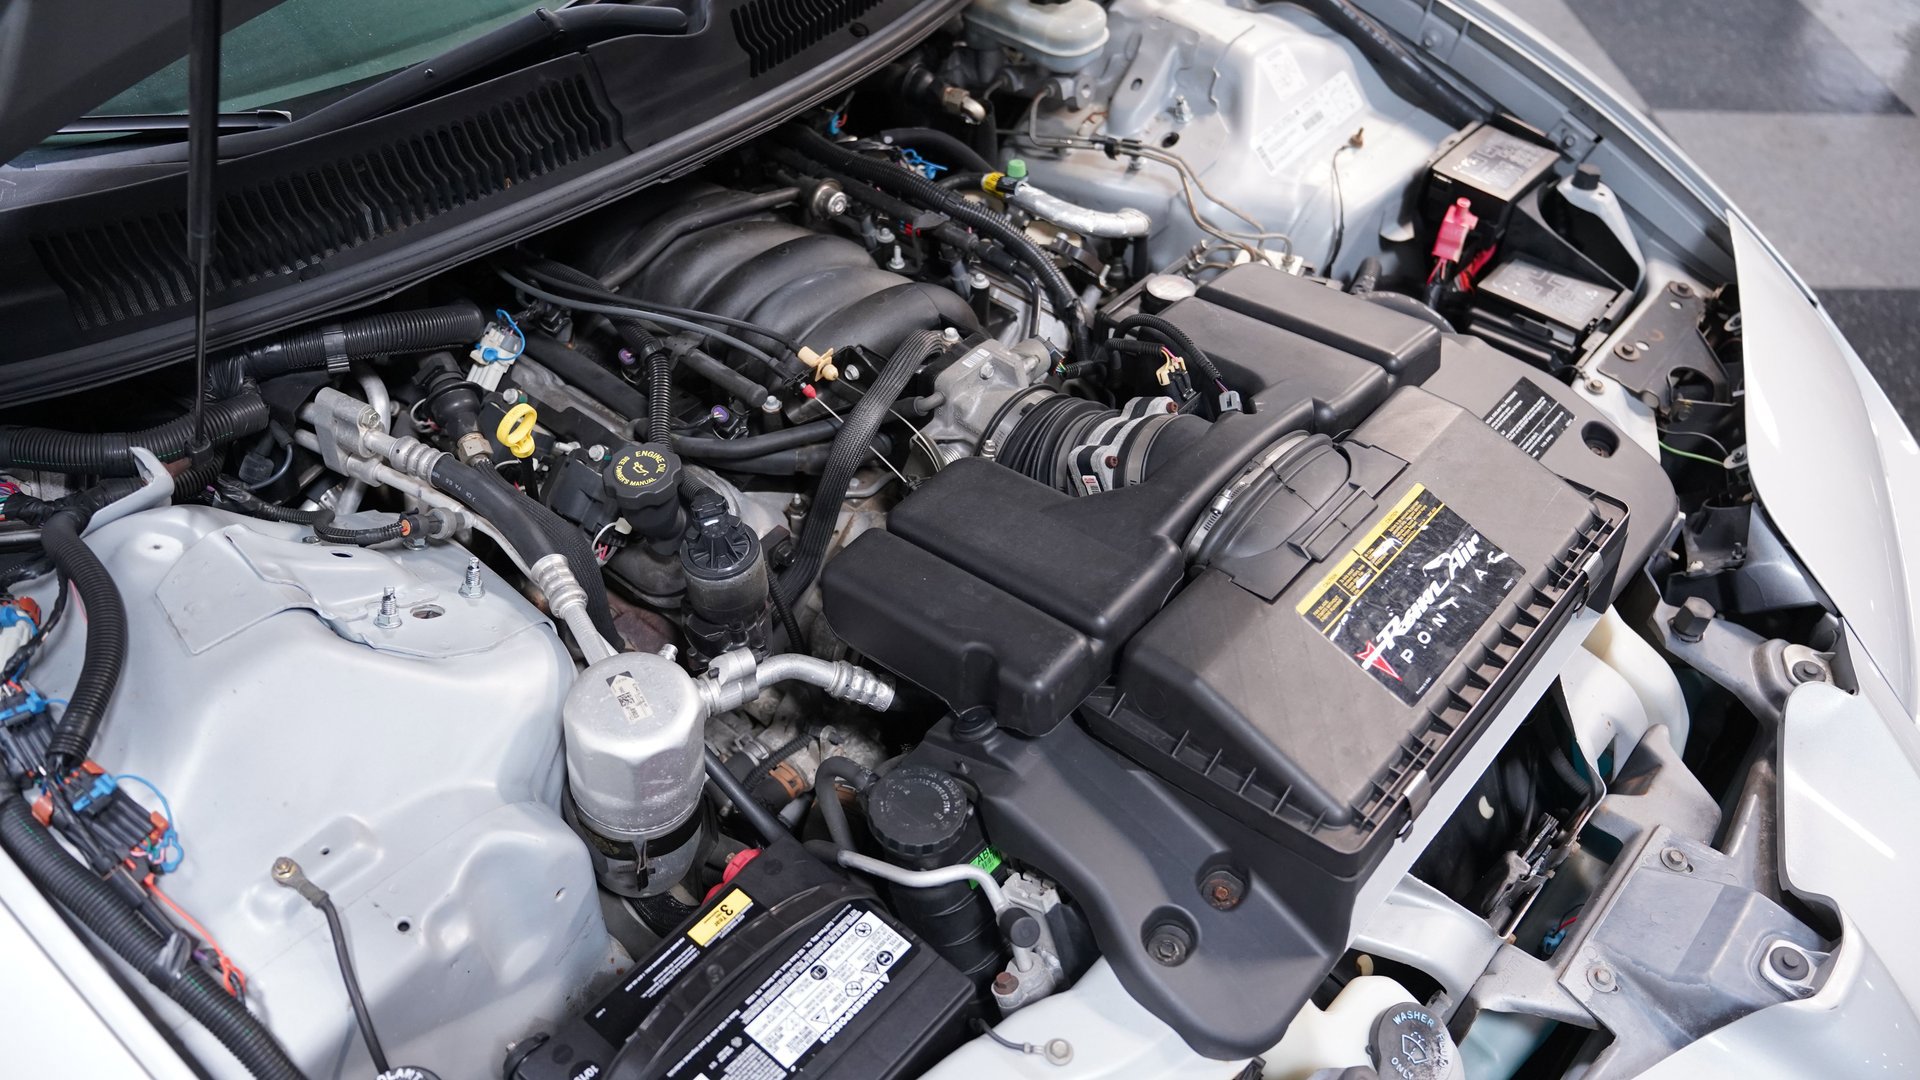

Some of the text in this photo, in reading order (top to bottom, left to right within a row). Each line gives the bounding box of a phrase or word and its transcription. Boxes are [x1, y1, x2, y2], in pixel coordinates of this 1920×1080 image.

[615, 455, 657, 487] SEE OWNER'S MANUAL
[635, 450, 667, 474] ENGINE OIL
[1447, 533, 1480, 580] Air
[1400, 551, 1503, 664] PONTIAC
[720, 904, 733, 915] 3
[820, 981, 885, 1044] DANGER/POISON
[1393, 1011, 1434, 1026] WASHER
[1436, 1032, 1448, 1070] FLUID
[1391, 1057, 1414, 1079] ONLY
